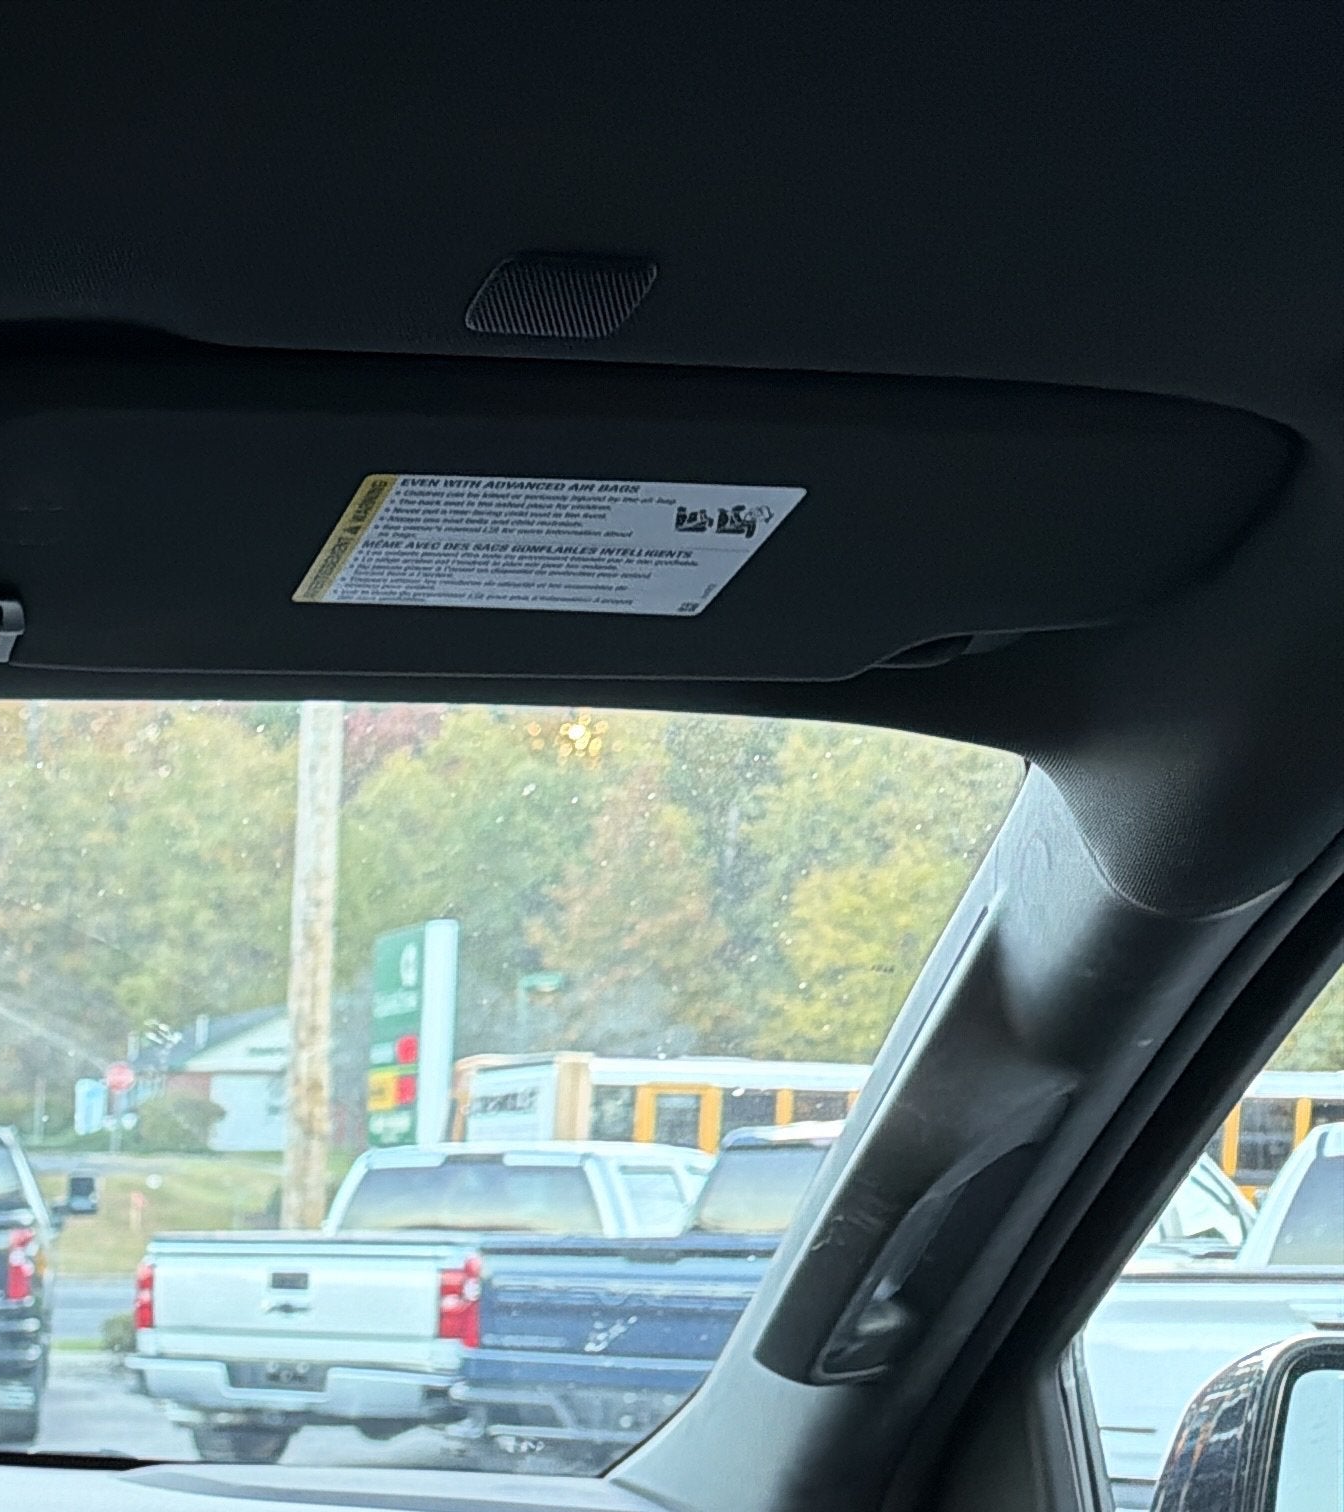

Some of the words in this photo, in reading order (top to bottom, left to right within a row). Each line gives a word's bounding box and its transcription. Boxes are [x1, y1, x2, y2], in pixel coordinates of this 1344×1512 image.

[400, 478, 442, 488] EVEN
[443, 479, 482, 489] WITH
[483, 480, 566, 491] ADVANCED
[568, 483, 596, 491] AIR
[598, 484, 641, 494] BAGS
[405, 541, 440, 550] AVEC
